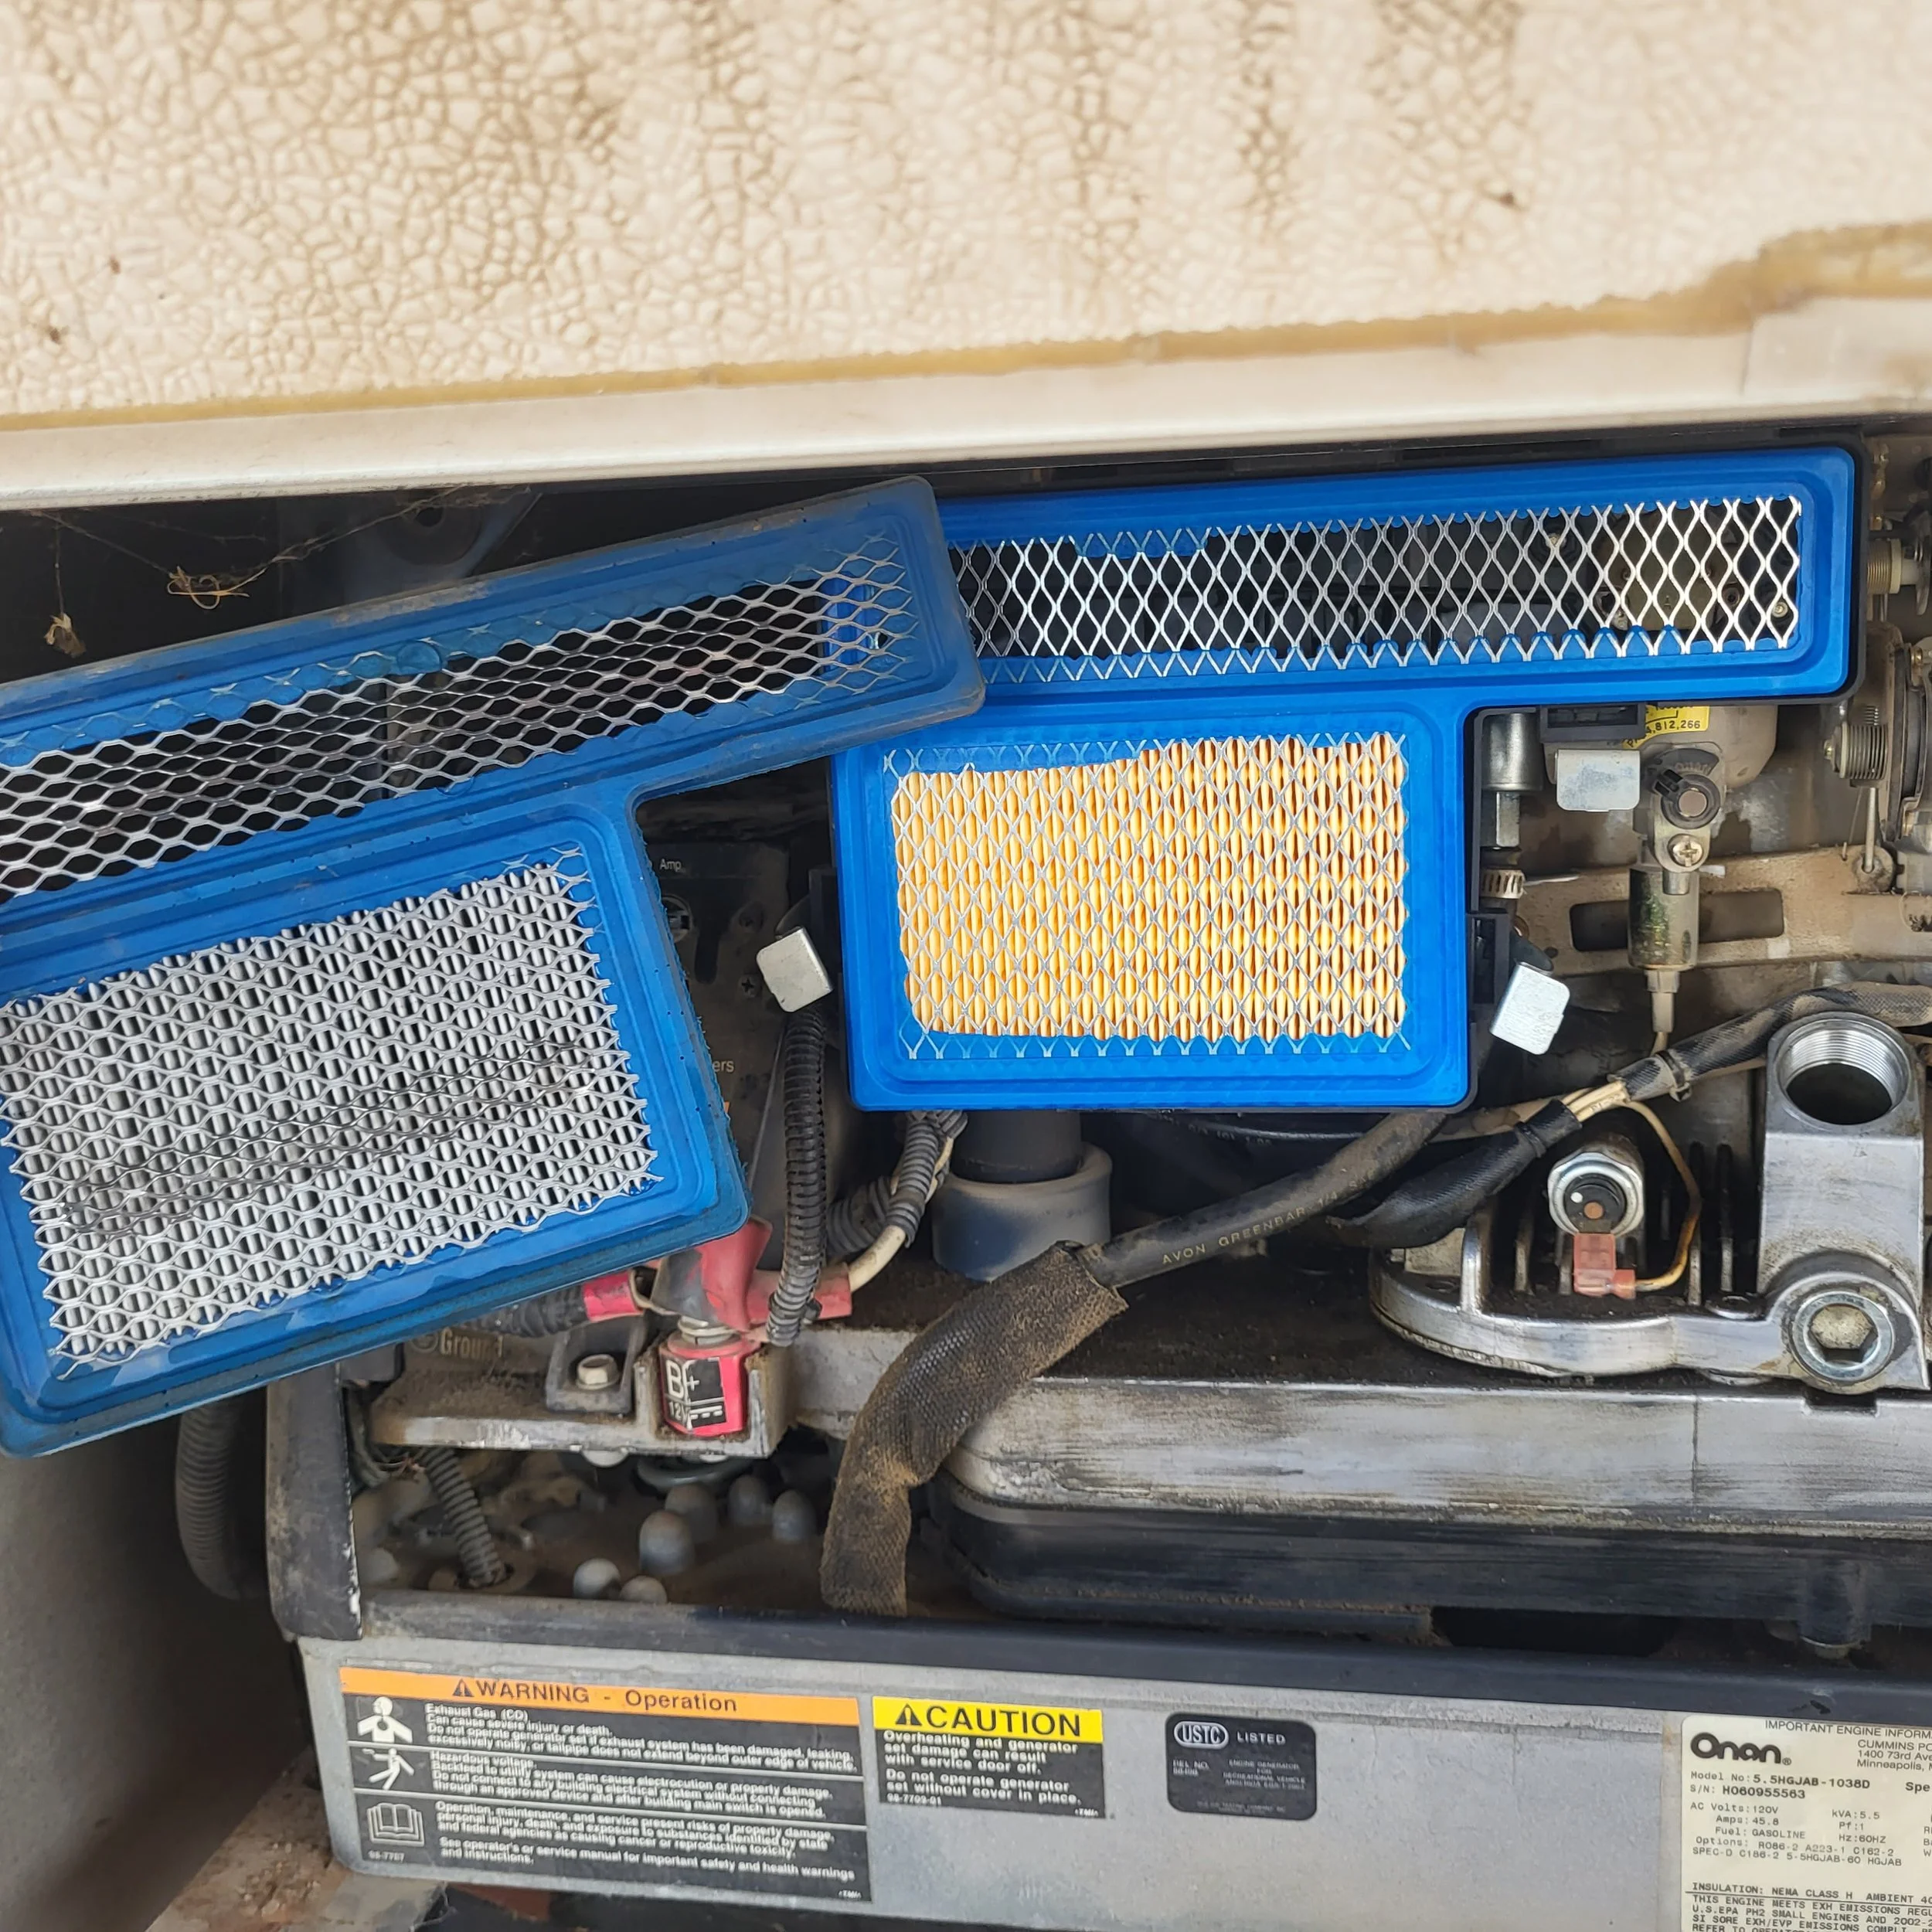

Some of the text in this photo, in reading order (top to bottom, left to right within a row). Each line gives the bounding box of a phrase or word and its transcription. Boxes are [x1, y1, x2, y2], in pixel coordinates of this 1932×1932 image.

[1162, 1243, 1206, 1265] AVON
[1219, 1207, 1305, 1247] GREENBAR
[476, 1680, 590, 1703] WARNING
[625, 1689, 737, 1714] Operation
[472, 1706, 495, 1719] Gas
[927, 1705, 1080, 1736] CAUTION
[561, 1723, 573, 1735] or
[1182, 1724, 1286, 1745] USTC LISTED
[1765, 1720, 1833, 1733] IMPORTANT
[1836, 1725, 1881, 1735] ENGINE
[691, 1741, 713, 1753] has
[715, 1743, 745, 1755] been
[883, 1730, 1078, 1754] Overheating and generator
[1690, 1732, 1781, 1764] Onan
[1857, 1740, 1914, 1750] CUMMINS
[685, 1750, 729, 1766] beyond
[731, 1753, 761, 1767] outer
[764, 1756, 794, 1770] edge
[795, 1758, 808, 1770] of
[884, 1742, 1046, 1764] set damage can result
[1858, 1750, 1883, 1758] 1400
[1887, 1751, 1910, 1760] 73rd
[885, 1753, 914, 1766] with
[920, 1755, 971, 1770] service
[978, 1759, 1011, 1773] door
[1857, 1759, 1924, 1771] Minneapolis,
[886, 1768, 1069, 1792] Do not operate generator
[1691, 1770, 1723, 1781] Model
[636, 1774, 713, 1791] electrocution
[714, 1781, 727, 1791] or
[730, 1781, 780, 1796] property
[886, 1781, 1081, 1804] set without cover in place.
[1690, 1801, 1704, 1810] AC
[732, 1821, 781, 1837] property
[1752, 1828, 1806, 1839] GASOLINE
[699, 1855, 735, 1872] safety
[737, 1859, 760, 1872] and
[762, 1860, 798, 1874] health
[1867, 1856, 1902, 1866] HGJAB
[1692, 1882, 1763, 1894] INSULATION:
[1771, 1886, 1799, 1896] NEMA
[1805, 1889, 1839, 1898] CLASS
[1866, 1892, 1914, 1903] AMBIENT
[1692, 1894, 1719, 1904] THIS
[1725, 1896, 1765, 1906] ENGINE
[1772, 1899, 1805, 1909] MEETS
[1812, 1901, 1832, 1910] EXH
[1839, 1903, 1900, 1914] EMISSIONS
[1692, 1914, 1706, 1923] SI
[1712, 1915, 1738, 1924] SORE
[1798, 1920, 1859, 1932] EMISSIONS
[1746, 1907, 1765, 1916] PH2
[1771, 1909, 1805, 1919] SMALL
[1812, 1911, 1859, 1922] ENGINES
[1866, 1914, 1886, 1924] AND
[1692, 1923, 1724, 1932] REFER
